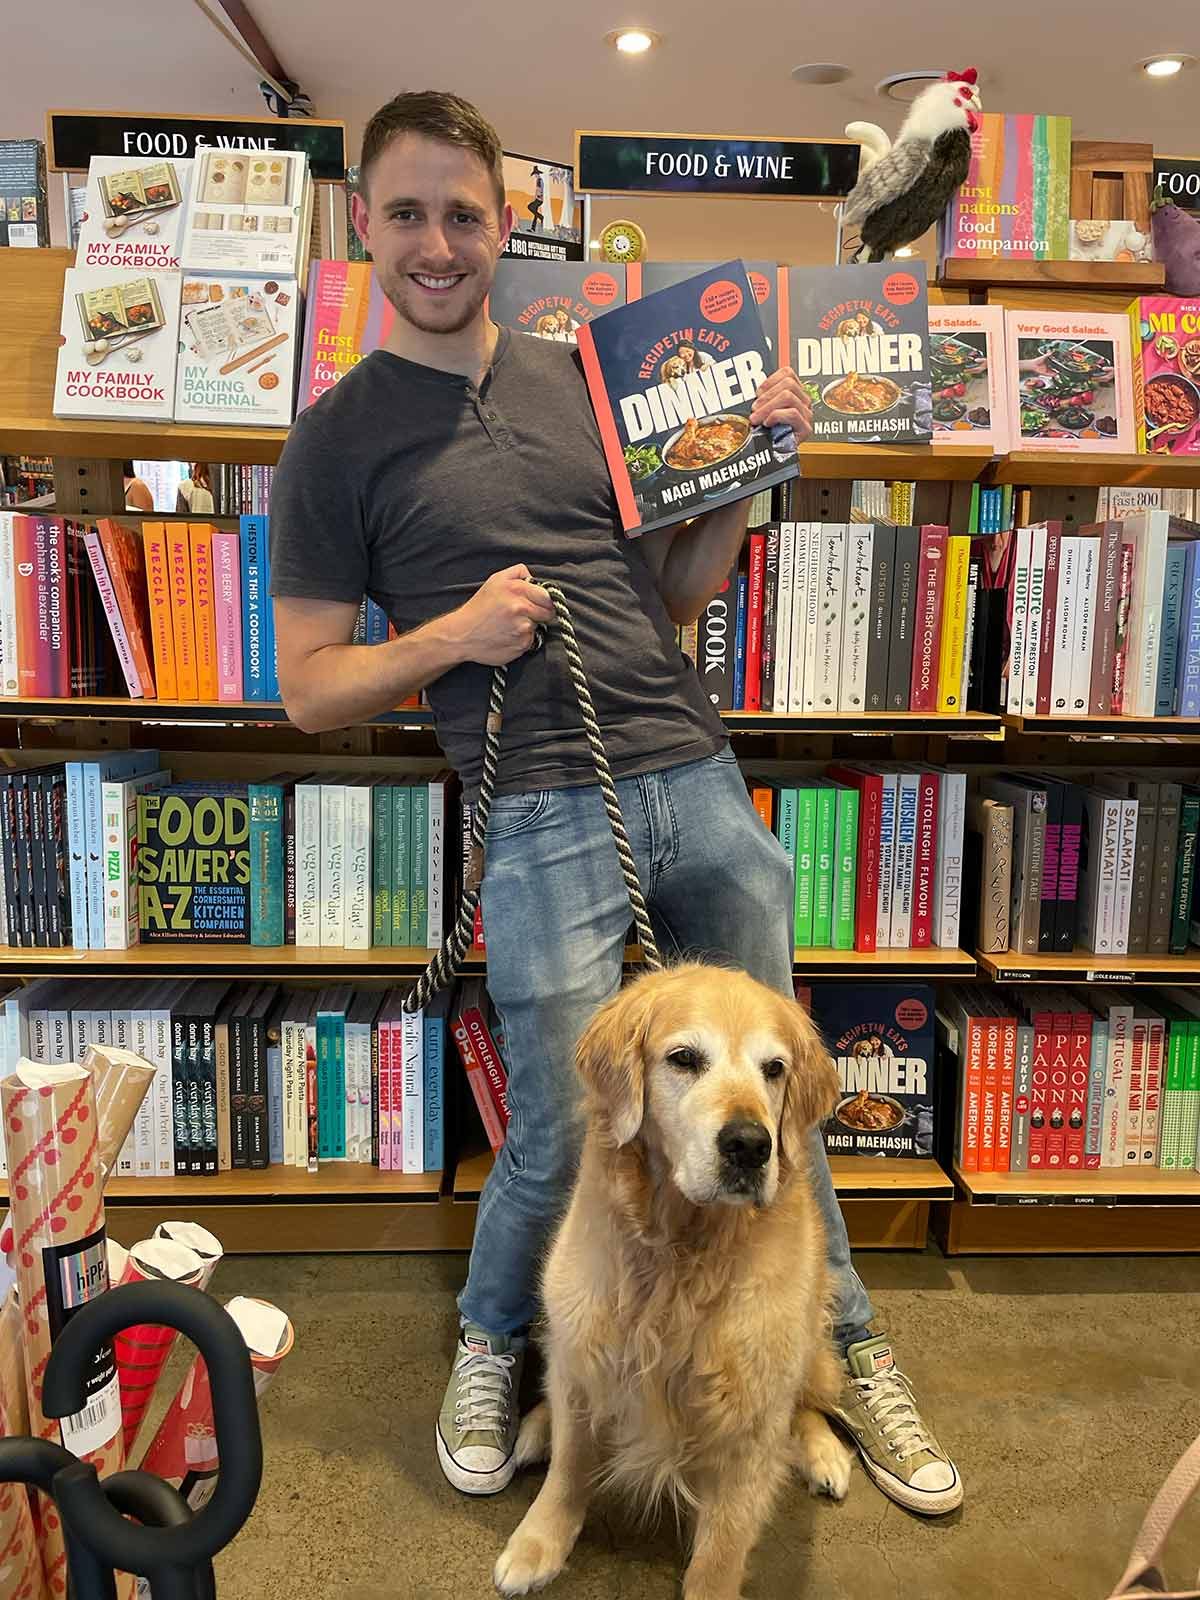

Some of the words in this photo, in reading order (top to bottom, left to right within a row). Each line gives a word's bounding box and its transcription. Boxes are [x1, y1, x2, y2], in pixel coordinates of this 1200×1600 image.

[123, 132, 188, 155] FOOD
[645, 152, 709, 177] FOOD
[714, 158, 731, 178] &
[736, 155, 794, 180] WINE
[959, 201, 1019, 216] nations
[960, 184, 992, 198] first
[958, 218, 995, 234] food
[86, 254, 181, 268] COOKBOOK
[87, 243, 106, 255] MY
[109, 243, 170, 256] FAMILY
[512, 239, 528, 256] BBQ
[957, 236, 1050, 255] companion
[517, 296, 572, 325] RECIPETIN
[819, 300, 873, 330] RECIPETIN
[874, 303, 900, 328] EATS
[1149, 312, 1176, 333] MI
[1017, 324, 1040, 334] Very
[1043, 325, 1070, 334] Good
[638, 327, 694, 379] RECIPETIN
[697, 328, 731, 353] EATS
[798, 333, 924, 377] DINNER
[66, 370, 91, 384] MY
[96, 371, 154, 386] FAMILY
[183, 378, 245, 393] BAKING
[184, 366, 209, 379] MY
[65, 385, 165, 400] COOKBOOK
[182, 391, 260, 407] JOURNAL
[619, 350, 768, 443] DINNER
[814, 421, 843, 434] NAGI
[848, 418, 910, 433] MAEHASHI
[661, 482, 697, 505] NAGI
[699, 449, 772, 491] MAEHASHI
[1112, 495, 1136, 506] fast
[1137, 492, 1159, 506] 800
[35, 524, 48, 581] stephanie
[49, 526, 60, 544] the
[248, 523, 256, 563] HESTON
[754, 545, 761, 553] To
[767, 529, 778, 573] FAMILY
[1109, 531, 1118, 548] The
[50, 548, 61, 583] cook's
[87, 544, 102, 575] Lunch
[221, 541, 231, 569] MARY
[249, 566, 258, 575] IS
[782, 529, 791, 592] COMMUNITY
[798, 529, 806, 592] COMMUNITY
[1106, 551, 1116, 579] Shared
[97, 578, 106, 587] in
[151, 543, 164, 606] MEZCLA
[174, 543, 186, 606] MEZCLA
[196, 544, 208, 607] MEZCLA
[222, 574, 232, 603] BERRY
[249, 579, 258, 600] THIS
[808, 532, 818, 624] NEIGHBOURHOOD
[878, 562, 887, 603] OUTSIDE
[901, 562, 910, 603] OUTSIDE
[928, 568, 937, 587] THE
[1016, 568, 1028, 614] more
[1031, 568, 1043, 615] more
[1170, 561, 1180, 590] RICK
[38, 585, 49, 641] alexander
[101, 590, 115, 615] Paris
[925, 590, 935, 627] BRITISH
[1103, 580, 1113, 611] Kitchen
[1167, 595, 1178, 631] STEIN
[50, 587, 62, 649] companion
[1030, 621, 1038, 640] MATT
[250, 614, 260, 679] COOKBOOK?
[705, 600, 728, 674] COOK
[1147, 624, 1155, 650] CLARE
[1165, 636, 1174, 648] AT
[921, 631, 933, 690] COOKBOOK
[1013, 642, 1022, 675] PRESTON
[1029, 642, 1037, 676] PRESTON
[1145, 656, 1153, 687] SMYTH
[1161, 652, 1172, 688] HOME
[136, 795, 250, 847] FOOD
[899, 787, 916, 843] JERUSALEM
[921, 787, 934, 861] OTTOLENGHI
[866, 792, 876, 898] OTTOLENGHI
[897, 844, 905, 862] SAMI
[1103, 808, 1117, 880] SALAMATI
[1120, 808, 1135, 880] SALAMATI
[1182, 833, 1196, 875] Persiana
[108, 850, 120, 881] PIZZA
[138, 846, 251, 885] SAVER'S
[896, 864, 904, 890] TAMIMI
[1058, 824, 1081, 900] RAMBUTAN
[193, 895, 246, 905] CORNERSMITH
[194, 886, 208, 895] THE
[209, 886, 244, 895] ESSENTIAL
[882, 870, 891, 913] OTTOLENGHI
[902, 870, 911, 914] OTTOLENGHI
[918, 867, 929, 917] FLAVOUR
[944, 856, 960, 921] PLENTY
[1178, 878, 1188, 920] EVERYDAY
[193, 905, 245, 919] KITCHEN
[193, 919, 245, 929] COMPANION
[427, 1027, 439, 1061] curry
[456, 1028, 475, 1064] OTK
[471, 1022, 502, 1088] OTTOLENGHI
[836, 1023, 886, 1050] RECIPETIN
[887, 1028, 909, 1052] EATS
[971, 1026, 981, 1069] KOREAN
[987, 1026, 997, 1069] KOREAN
[1004, 1026, 1014, 1069] KOREAN
[1112, 1015, 1126, 1082] PORTUGAL
[1132, 1025, 1144, 1070] Cinnamon
[1149, 1025, 1161, 1070] Cinnamon
[298, 1061, 306, 1080] Night
[405, 1054, 418, 1097] Natural
[1032, 1034, 1047, 1103] PAON
[1052, 1035, 1067, 1103] PAON
[1071, 1034, 1087, 1104] PAON
[1130, 1074, 1143, 1091] and
[1148, 1074, 1159, 1091] and
[427, 1067, 440, 1123] everyday
[1129, 1094, 1142, 1111] Salt
[1146, 1094, 1158, 1111] Salt
[968, 1092, 977, 1148] AMERICAN
[984, 1092, 992, 1148] AMERICAN
[1000, 1092, 1008, 1148] AMERICAN
[827, 1135, 853, 1148] NAGI
[856, 1136, 913, 1150] MAEHASHI
